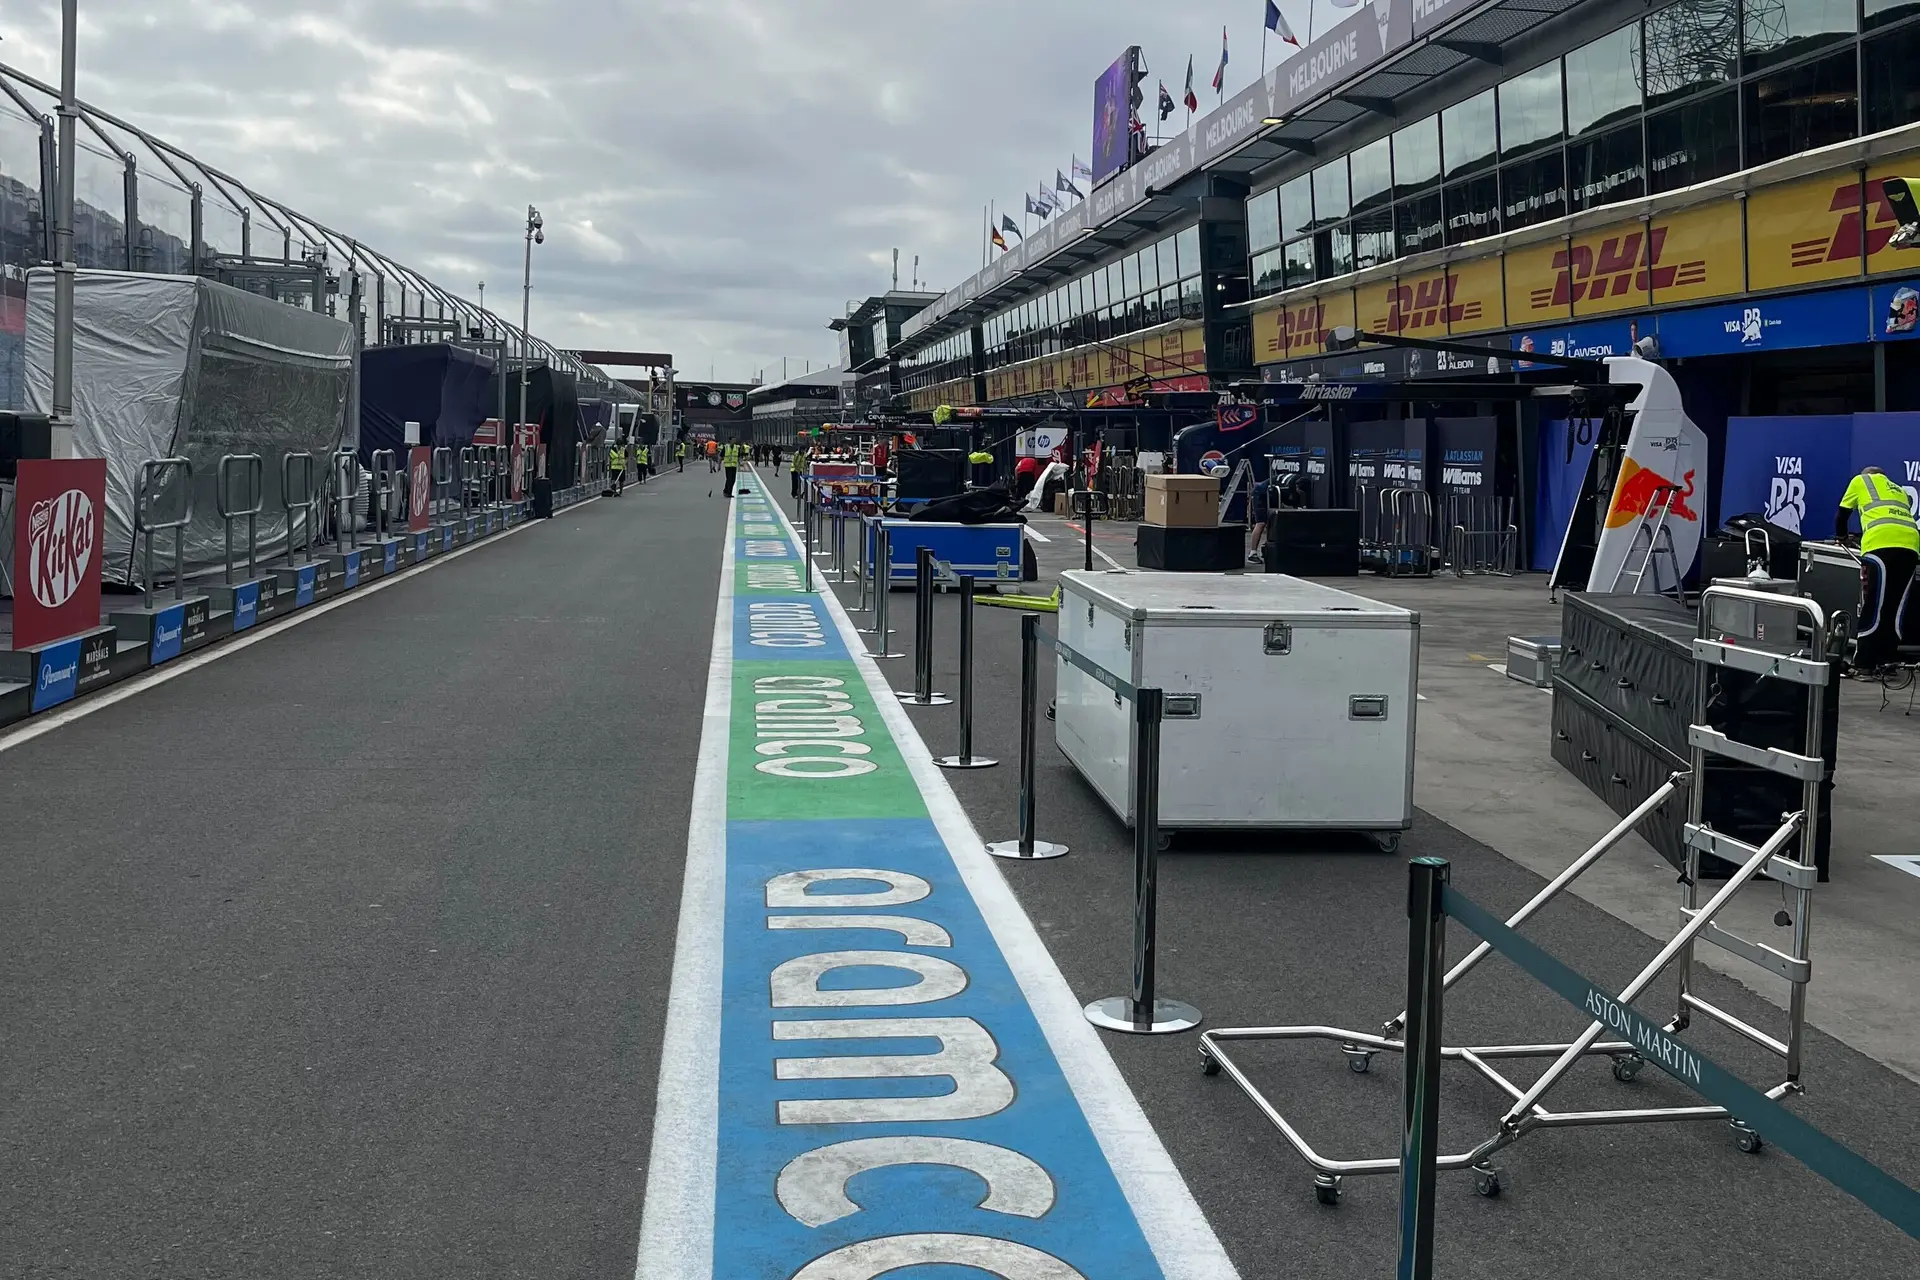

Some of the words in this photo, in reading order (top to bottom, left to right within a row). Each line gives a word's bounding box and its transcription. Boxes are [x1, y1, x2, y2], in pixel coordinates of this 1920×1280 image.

[1289, 30, 1358, 98] MELBOURNE
[1205, 98, 1254, 150] MELBOURNE
[1550, 226, 1679, 304] DHL
[1386, 274, 1465, 333] DHL
[1277, 304, 1330, 350] DHL
[1724, 320, 1740, 332] VISA
[1437, 351, 1446, 370] 23
[1551, 340, 1565, 356] 30
[1568, 345, 1612, 358] LAWSON
[1449, 360, 1473, 369] ALBON
[1299, 384, 1357, 399] Airtasker
[1450, 450, 1483, 460] ATLASSIAN
[1775, 456, 1802, 475] VISA
[1443, 467, 1482, 485] Williams
[37, 492, 92, 605] KitKat
[749, 602, 826, 647] aramco
[40, 661, 77, 691] Paramount+
[754, 675, 878, 779] aramco
[1585, 988, 1632, 1037] ASTON
[1637, 1020, 1700, 1084] MARTIN
